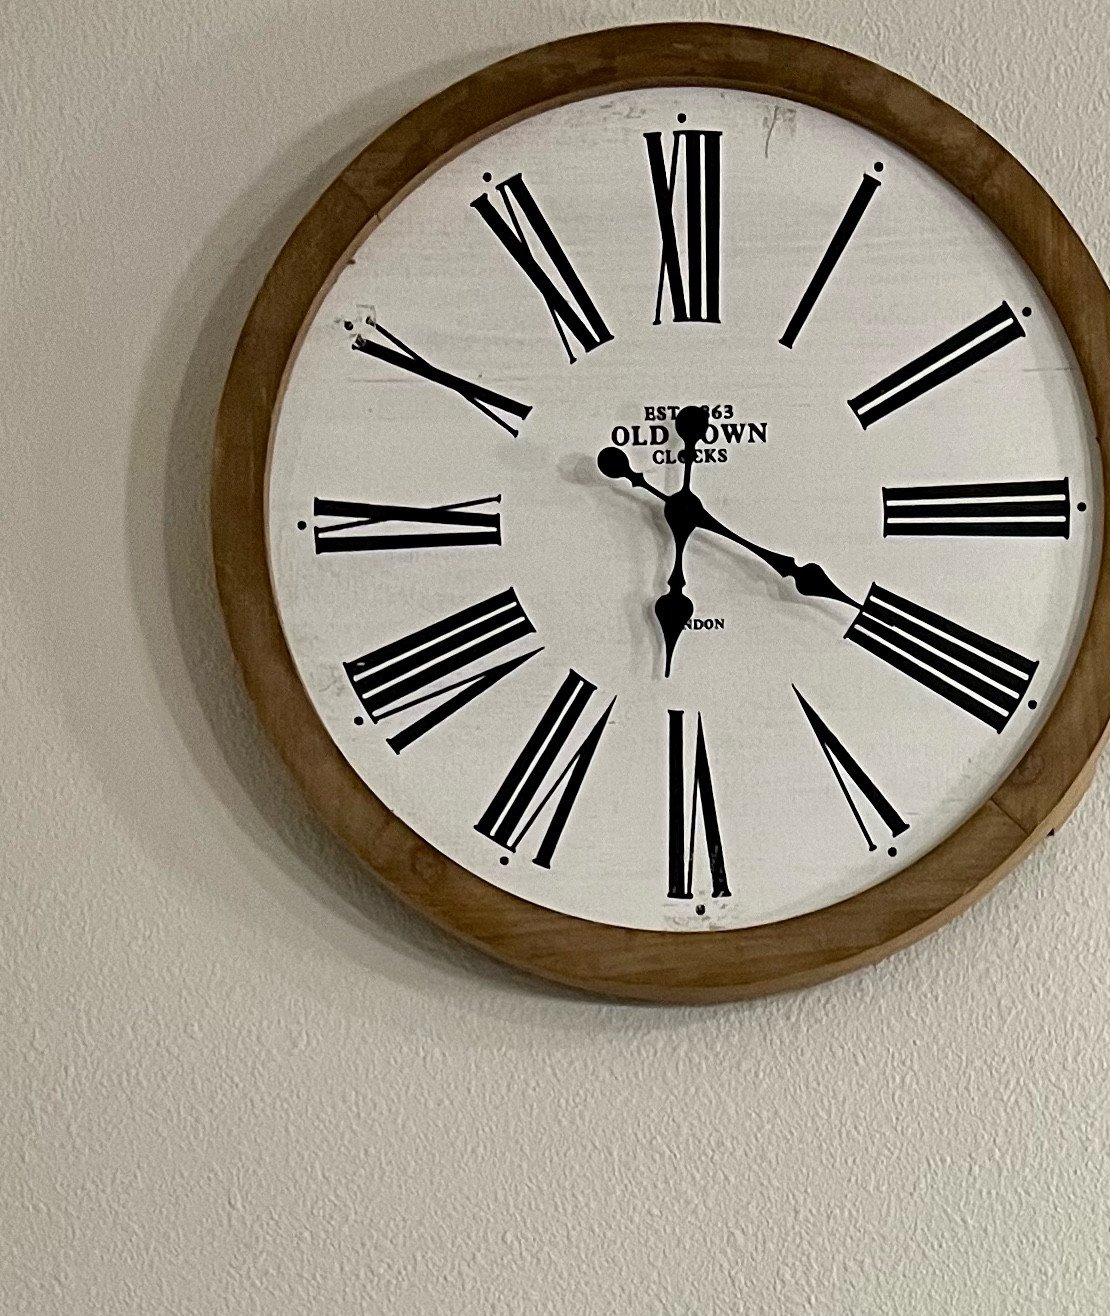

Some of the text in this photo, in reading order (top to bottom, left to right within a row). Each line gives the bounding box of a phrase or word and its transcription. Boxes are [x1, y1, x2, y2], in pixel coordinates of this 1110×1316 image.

[470, 173, 614, 364] XI
[643, 130, 723, 326] XII
[779, 173, 881, 349] I
[352, 316, 533, 438] X
[847, 301, 1026, 430] II
[611, 422, 768, 446] OLD OWN
[314, 493, 501, 554] IX
[882, 476, 1070, 540] III
[682, 618, 726, 631] NDON
[667, 709, 732, 898] VI
[791, 683, 910, 852] V
